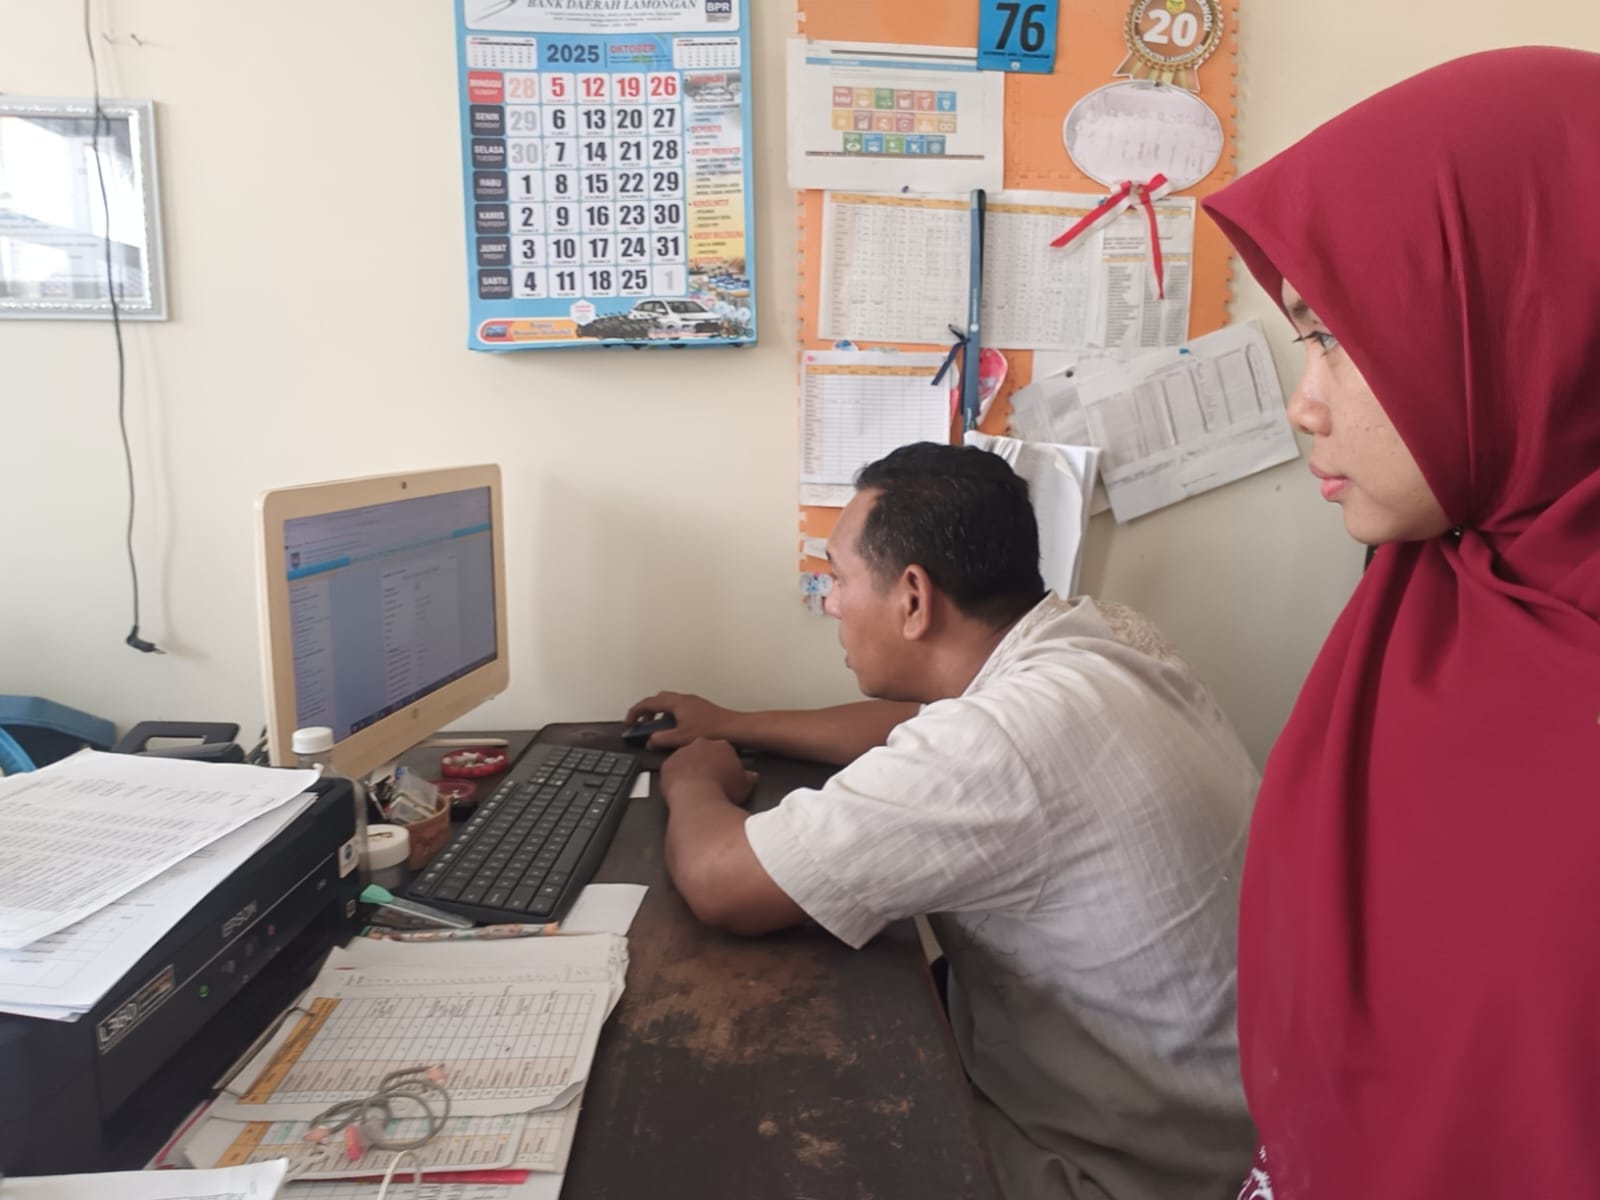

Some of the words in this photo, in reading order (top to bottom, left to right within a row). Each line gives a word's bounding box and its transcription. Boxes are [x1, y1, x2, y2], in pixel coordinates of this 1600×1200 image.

[527, 0, 562, 9] BANK
[566, 0, 621, 10] DAERAH
[624, 0, 697, 10] LAMONGAN
[706, 2, 731, 12] BPR
[996, 3, 1046, 52] 76
[1143, 9, 1198, 47] 20
[547, 44, 600, 63] 2025
[509, 77, 537, 98] 28
[552, 77, 564, 97] 5
[583, 77, 604, 97] 12
[617, 77, 640, 97] 19
[651, 76, 676, 96] 26
[510, 111, 537, 131] 29
[553, 109, 565, 129] 6
[583, 109, 605, 129] 13
[617, 109, 642, 128] 20
[654, 108, 675, 128] 27
[474, 145, 504, 153] SELASA
[511, 143, 539, 163] 30
[555, 142, 565, 161] 7
[584, 142, 606, 161] 14
[620, 141, 641, 160] 21
[653, 140, 678, 160] 28
[522, 175, 531, 194] 1
[556, 174, 567, 194] 8
[586, 174, 608, 193] 15
[619, 173, 643, 192] 22
[654, 172, 678, 191] 29
[522, 207, 533, 226] 2
[557, 207, 569, 226] 9
[587, 206, 609, 225] 16
[620, 205, 645, 225] 23
[654, 204, 680, 224] 30
[523, 239, 535, 259] 3
[553, 239, 575, 258] 10
[589, 238, 608, 258] 17
[621, 237, 645, 257] 24
[657, 237, 679, 256] 31
[524, 272, 536, 291] 4
[556, 272, 575, 290] 11
[589, 271, 611, 290] 18
[622, 270, 647, 289] 25
[664, 271, 673, 290] 1
[221, 901, 256, 937] EPSON
